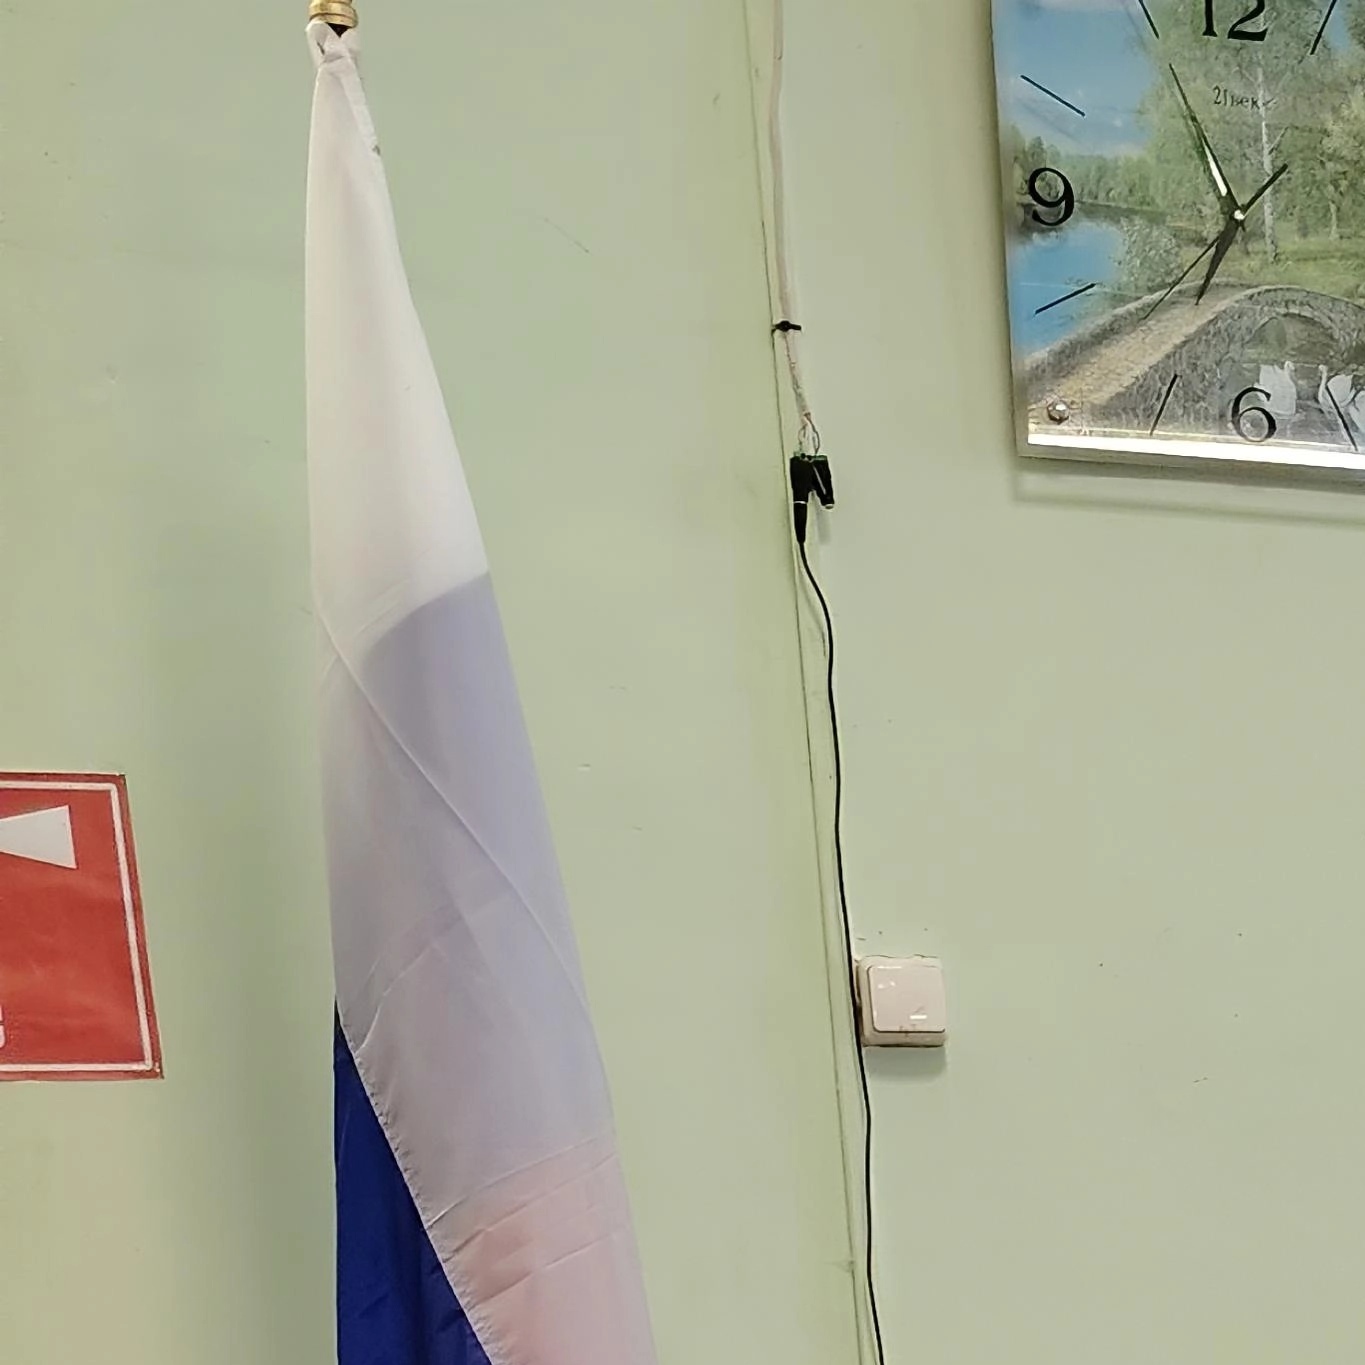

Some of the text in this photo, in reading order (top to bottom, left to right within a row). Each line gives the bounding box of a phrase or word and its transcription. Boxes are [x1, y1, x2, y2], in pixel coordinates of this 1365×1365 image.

[1202, 0, 1268, 41] 12
[1028, 167, 1075, 226] 9
[1231, 387, 1277, 442] 6
